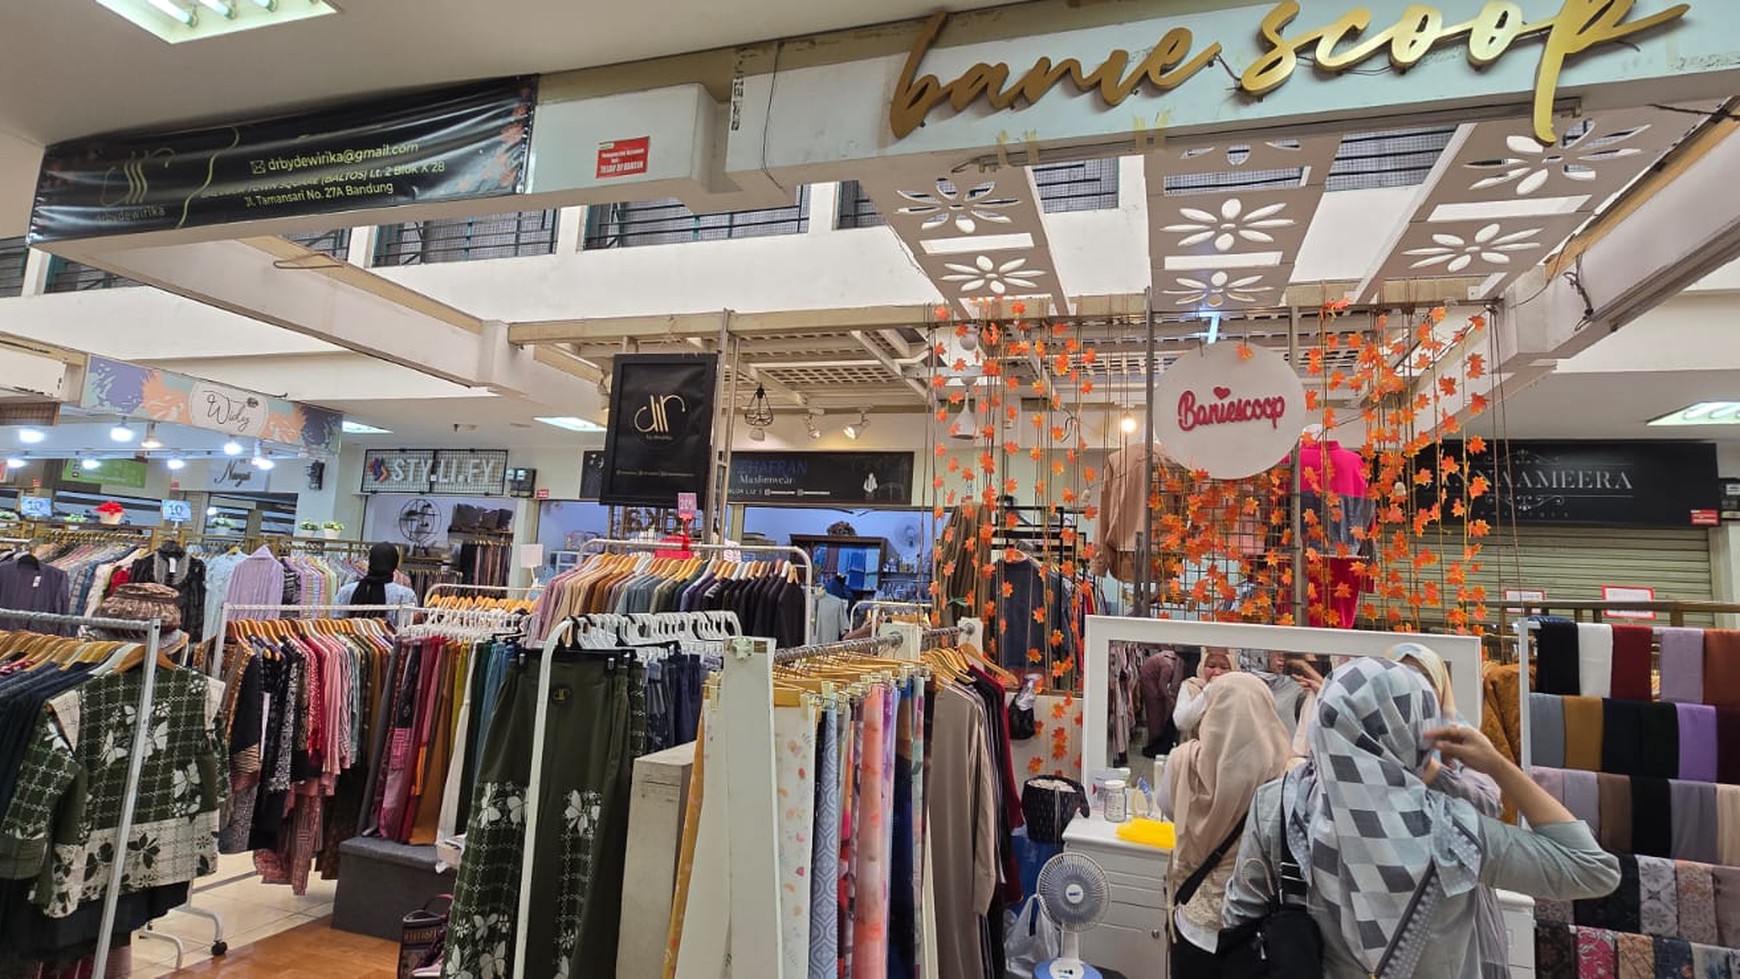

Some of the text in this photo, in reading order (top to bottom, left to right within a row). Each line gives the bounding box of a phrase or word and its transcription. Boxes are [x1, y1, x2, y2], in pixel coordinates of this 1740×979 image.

[268, 143, 419, 172] drbydewirika@gmail.com
[256, 189, 305, 206] Tamansari
[306, 188, 324, 200] No.
[324, 186, 343, 199] 27A
[344, 182, 395, 197] Bandung
[1177, 386, 1286, 431] Baniescoop
